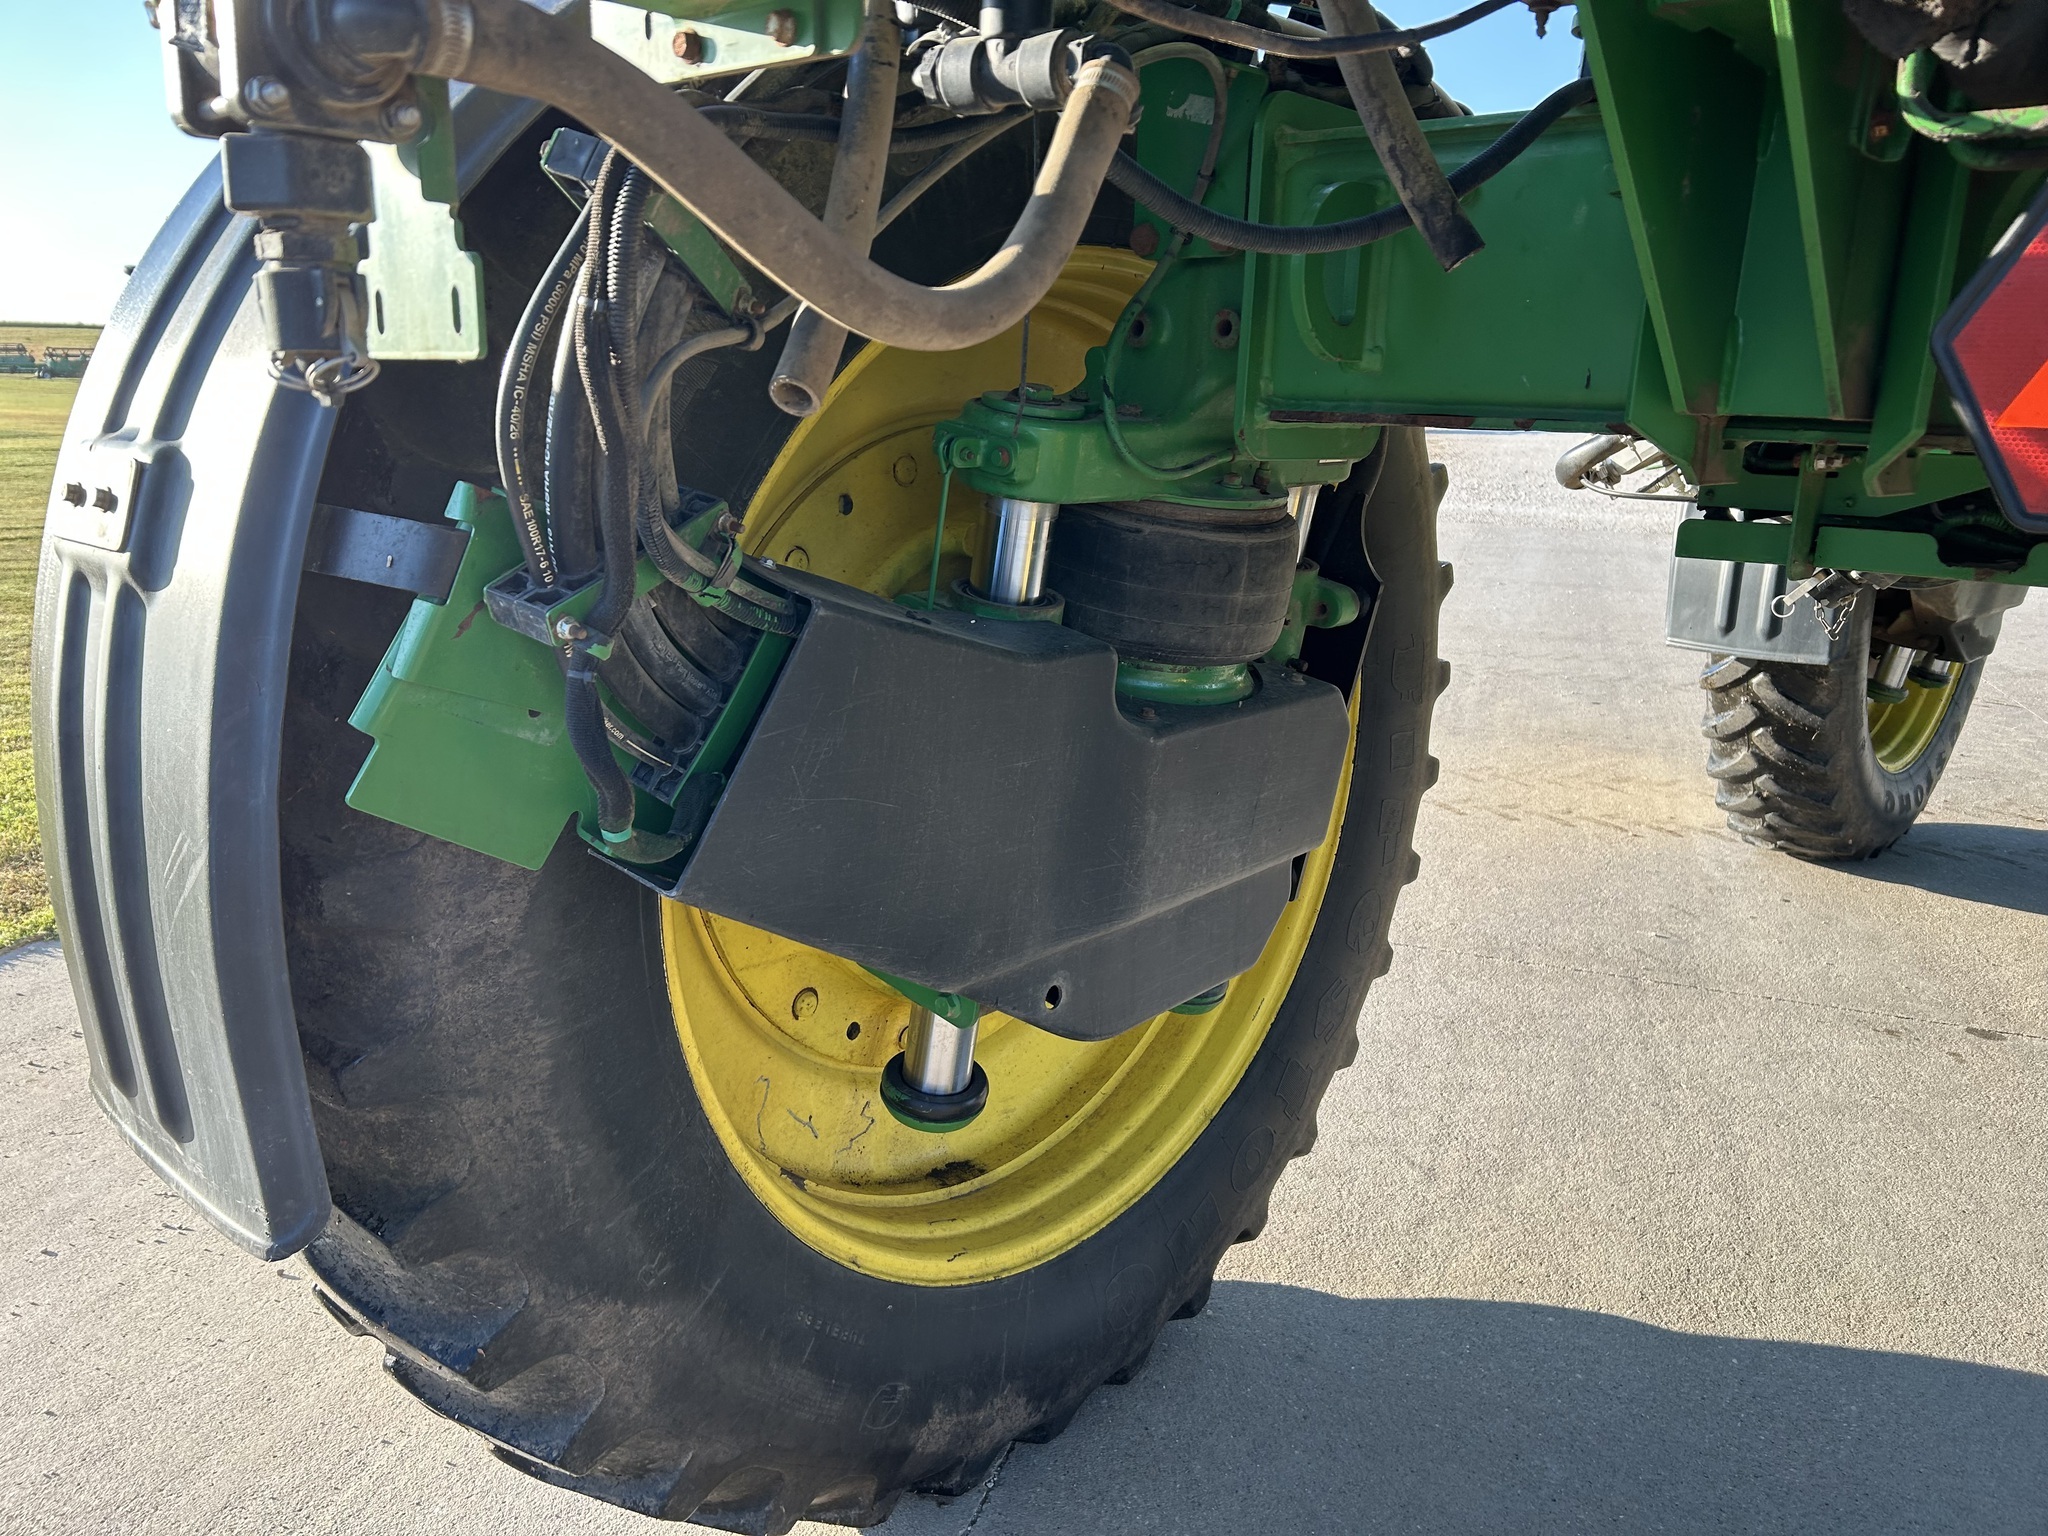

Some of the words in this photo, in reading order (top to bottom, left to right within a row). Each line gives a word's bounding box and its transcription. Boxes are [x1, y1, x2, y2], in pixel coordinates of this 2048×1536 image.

[564, 251, 586, 280] MPa
[544, 279, 568, 314] (3000
[532, 314, 550, 343] PSI)
[516, 341, 538, 383] MSHA
[509, 384, 526, 440] IC-40/26
[519, 492, 534, 520] SAE
